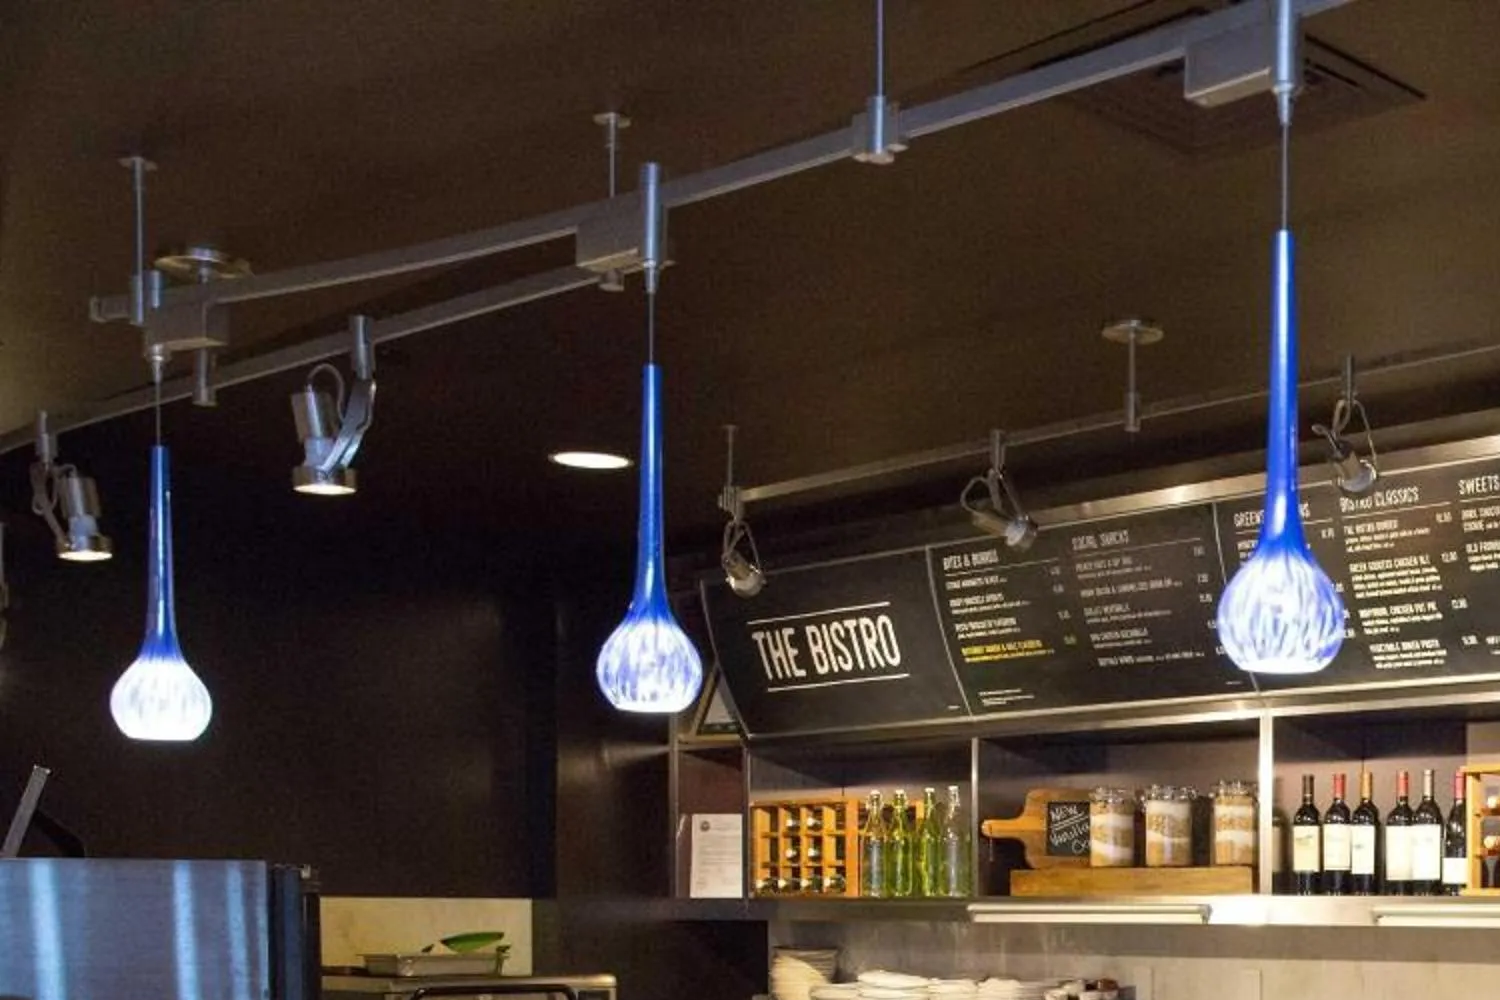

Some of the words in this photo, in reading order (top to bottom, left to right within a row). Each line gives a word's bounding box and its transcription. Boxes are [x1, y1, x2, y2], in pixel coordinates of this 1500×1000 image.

[1458, 474, 1500, 495] SWEETS
[752, 627, 807, 680] THE
[805, 614, 901, 675] BISTRO
